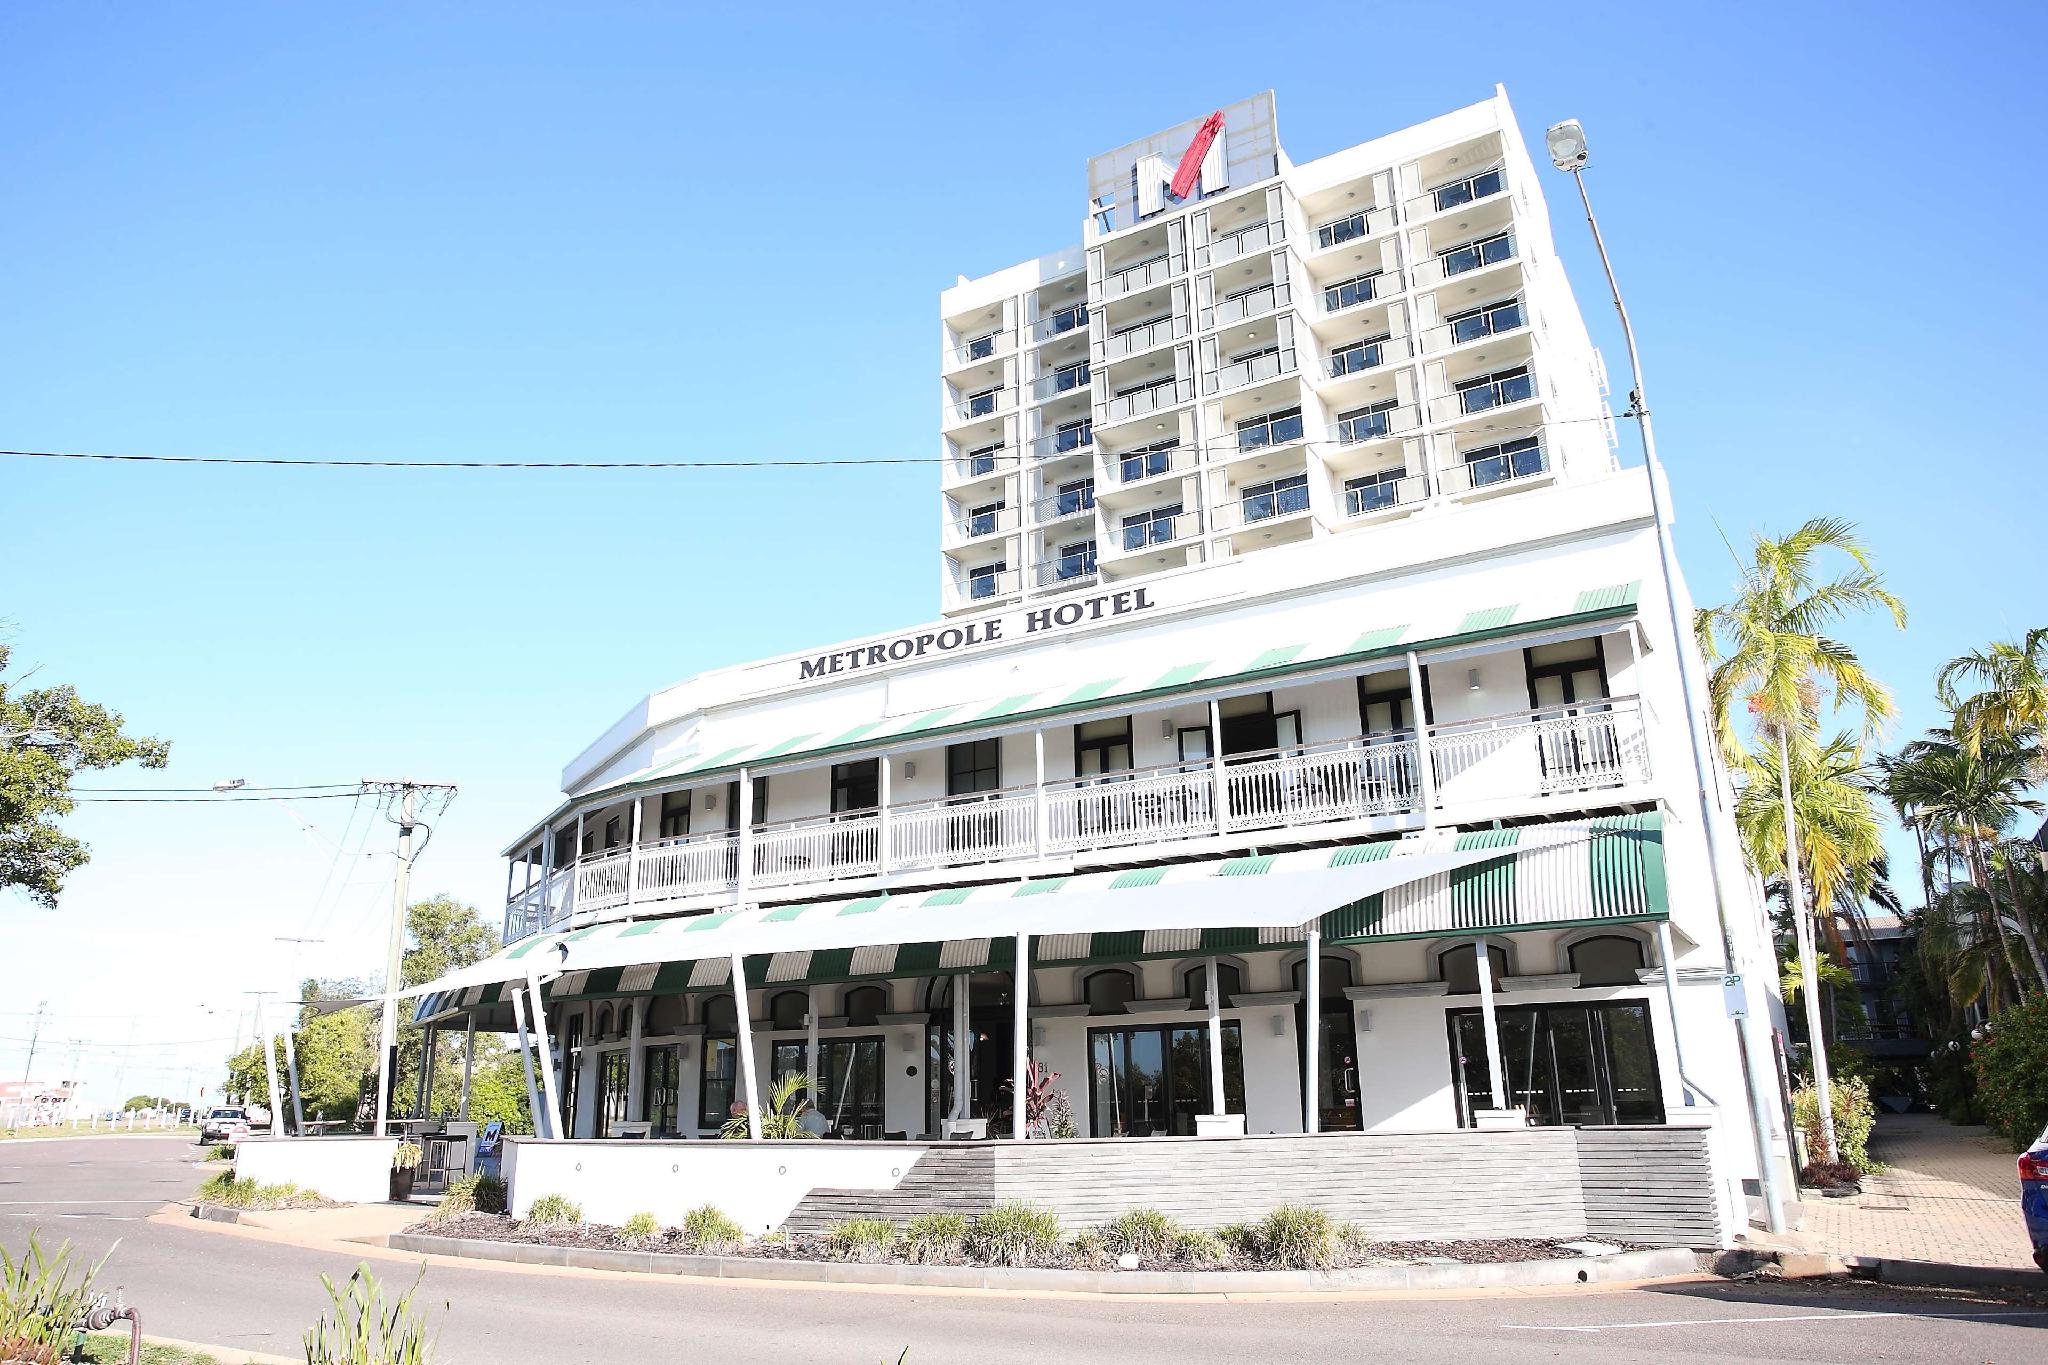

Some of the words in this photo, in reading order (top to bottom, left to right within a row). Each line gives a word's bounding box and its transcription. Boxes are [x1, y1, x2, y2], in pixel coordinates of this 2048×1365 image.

[799, 618, 1003, 680] METROPOLE
[1026, 587, 1155, 633] HOTEL
[1724, 975, 1741, 987] 2P
